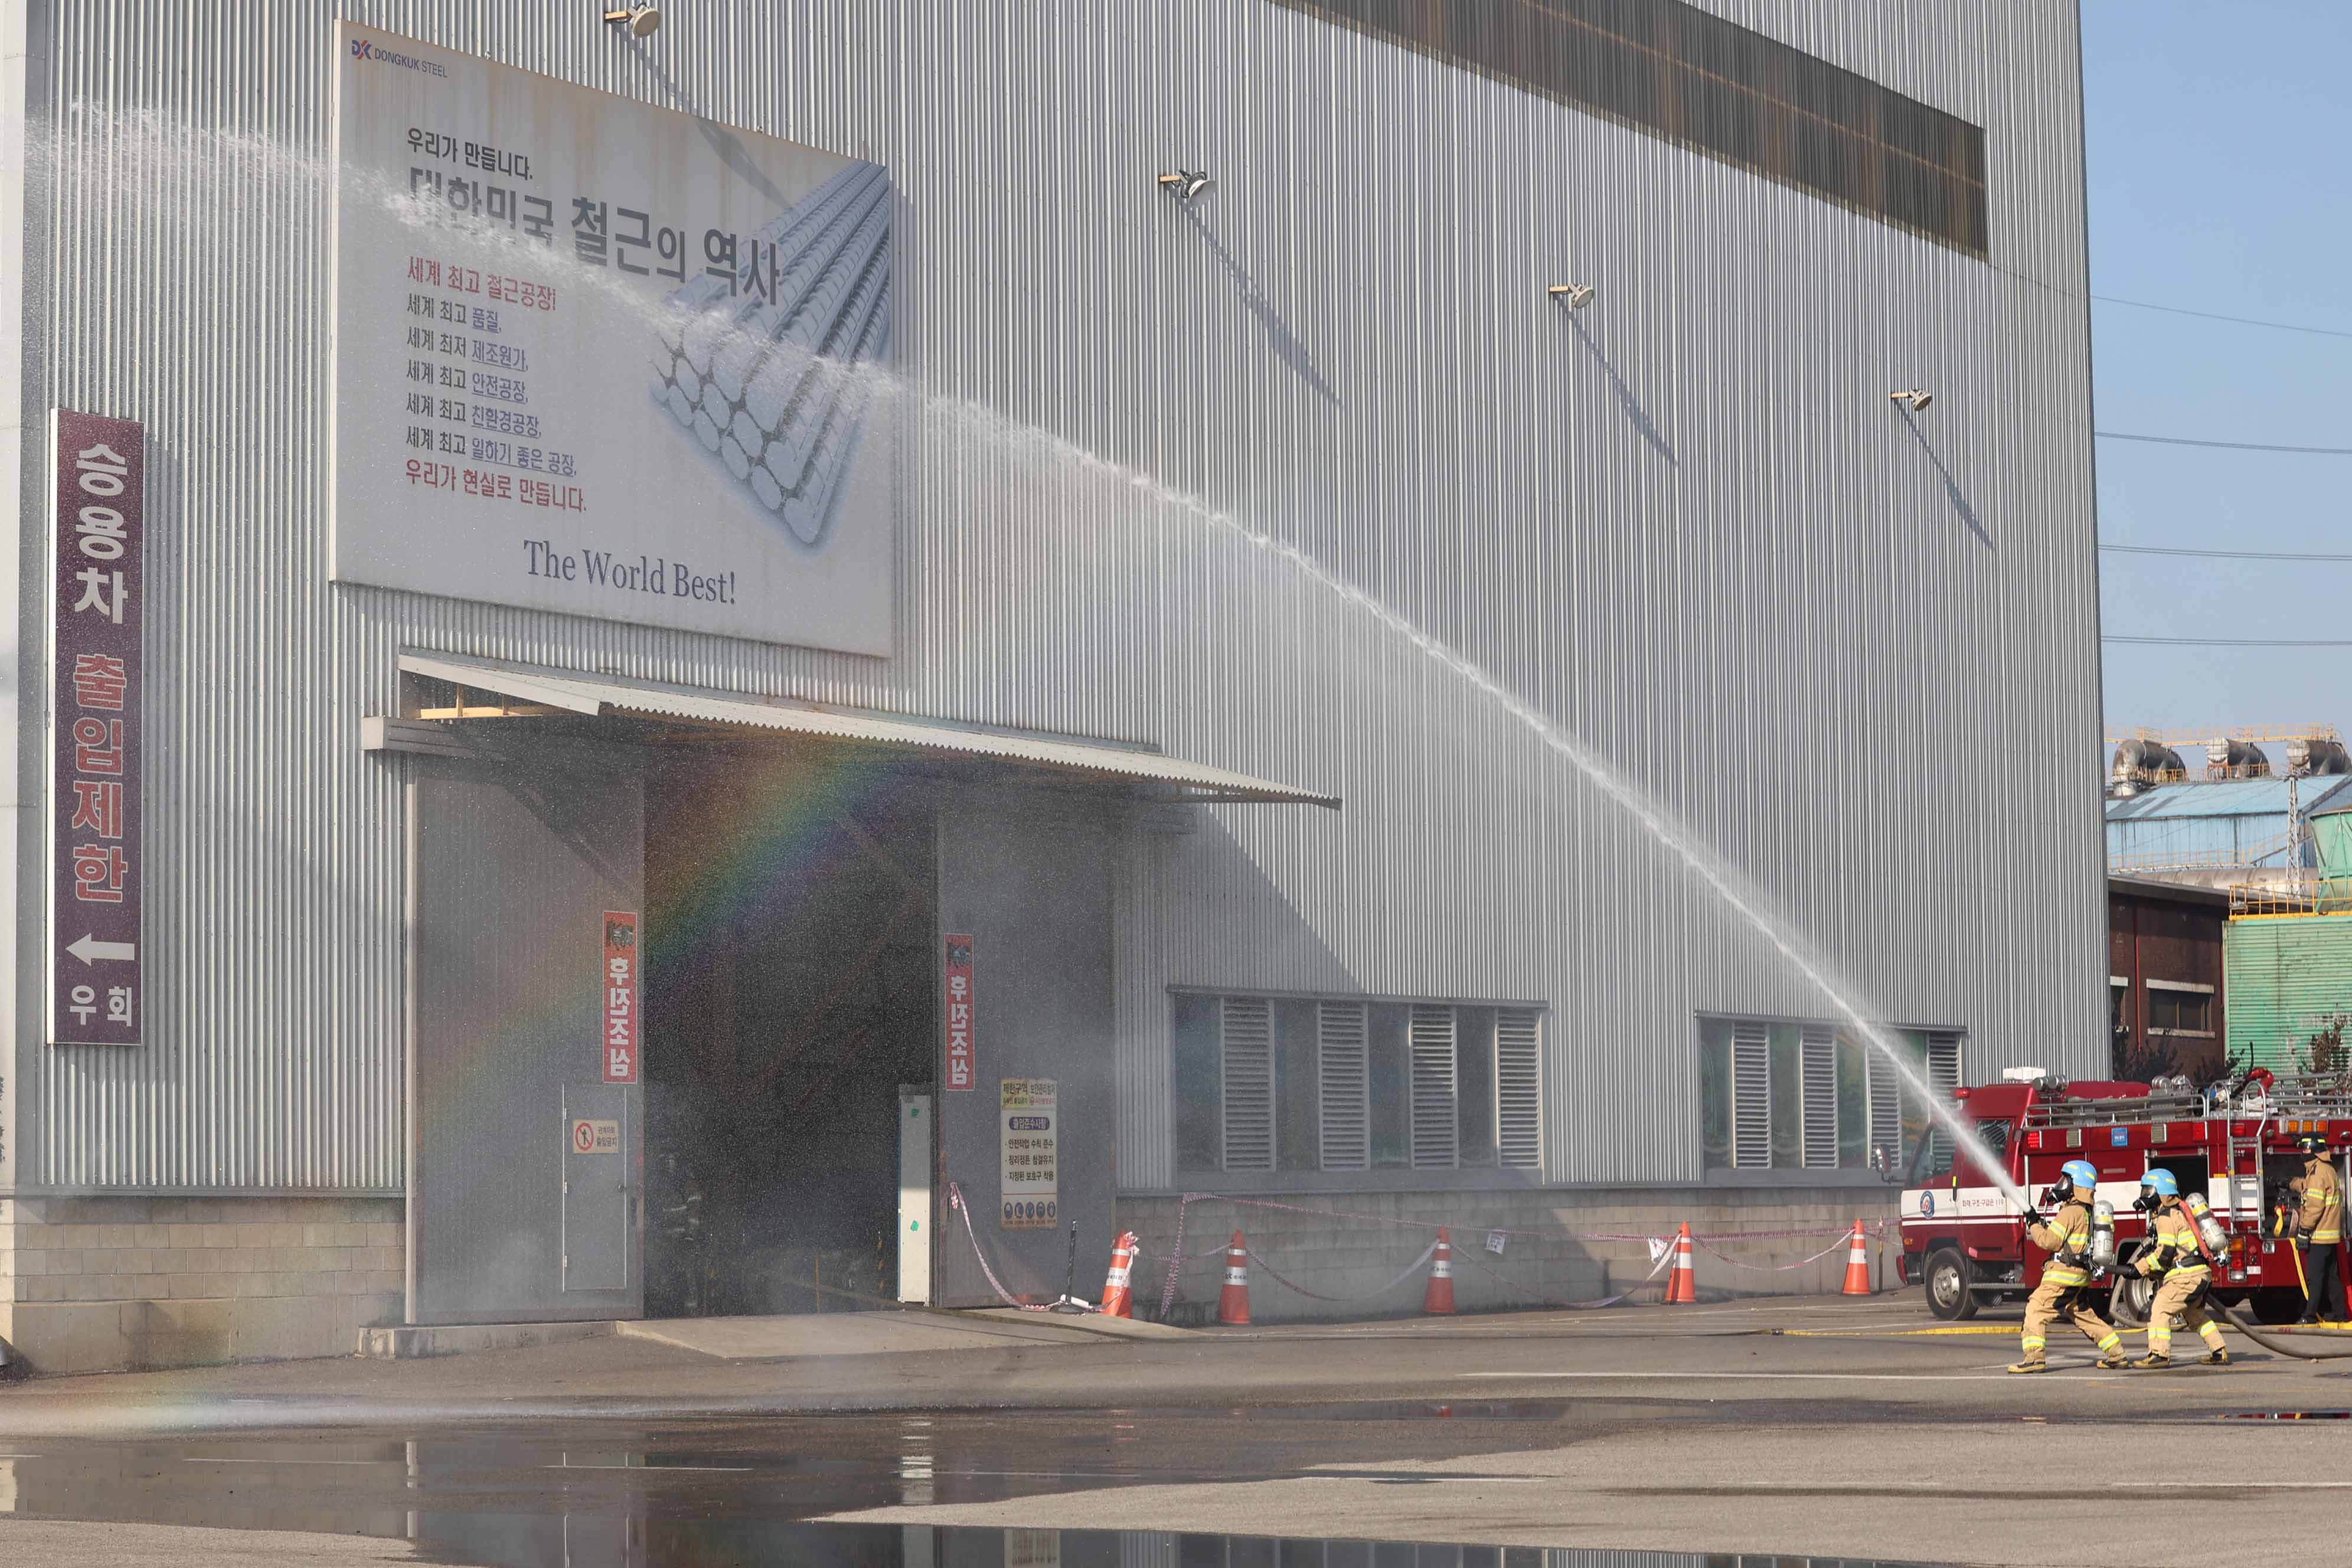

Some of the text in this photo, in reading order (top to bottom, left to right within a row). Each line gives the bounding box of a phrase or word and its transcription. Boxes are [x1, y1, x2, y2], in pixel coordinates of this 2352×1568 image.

[375, 48, 419, 71] DONGKUK
[422, 61, 447, 78] STEEL
[407, 128, 533, 180] 우리가 만듭니다.
[571, 197, 685, 283] 철근의
[704, 228, 779, 305] 역사
[407, 256, 556, 311] 세계 최고 철근공장!
[407, 293, 434, 319] 세계
[440, 300, 466, 324] 최고
[407, 326, 434, 351] 세계
[440, 333, 466, 358] 최저
[406, 359, 433, 384] 세계
[439, 365, 466, 389] 최고
[406, 393, 433, 417] 세계
[439, 398, 466, 422] 최고
[406, 426, 433, 450] 세계
[439, 432, 466, 455] 최고
[472, 437, 511, 464] 일하기
[517, 446, 543, 470] 좋은
[406, 459, 586, 512] 우리가 현실로 만듭니다.
[524, 540, 735, 605] The World Best!
[71, 443, 128, 903] 승용차 출입제한
[69, 984, 132, 1027] 우회
[1008, 1139, 1029, 1149] 안전작업
[1044, 1139, 1053, 1149] 준수
[1009, 1155, 1030, 1165] 정리정돈
[1027, 1171, 1041, 1181] 보호구
[1044, 1171, 1053, 1181] 착용
